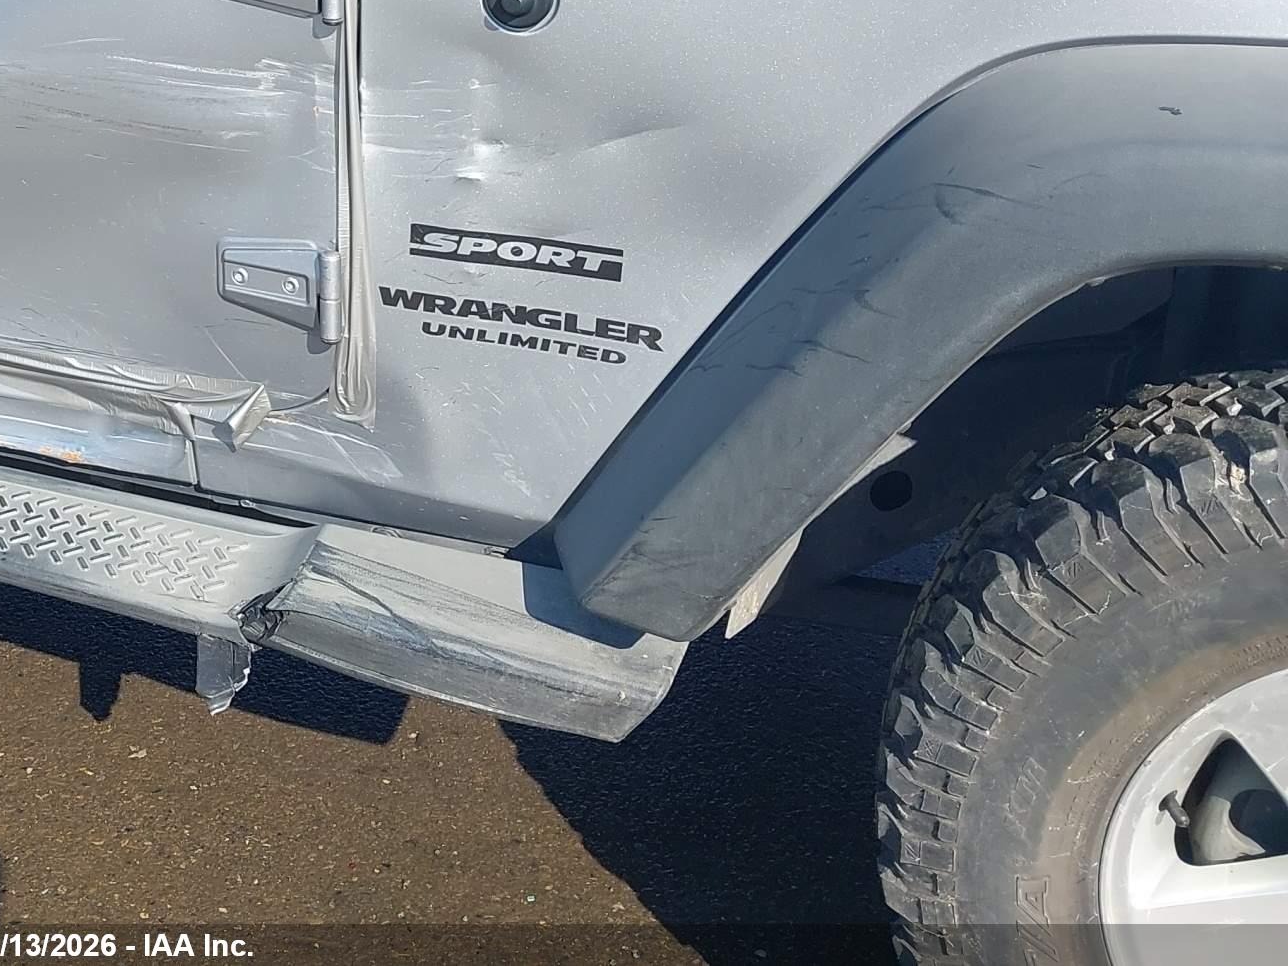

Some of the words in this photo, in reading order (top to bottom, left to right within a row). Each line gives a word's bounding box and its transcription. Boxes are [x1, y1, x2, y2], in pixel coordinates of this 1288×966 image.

[422, 232, 610, 272] SPORT
[378, 286, 664, 352] WRANGLER
[421, 321, 626, 365] UNLIMITED
